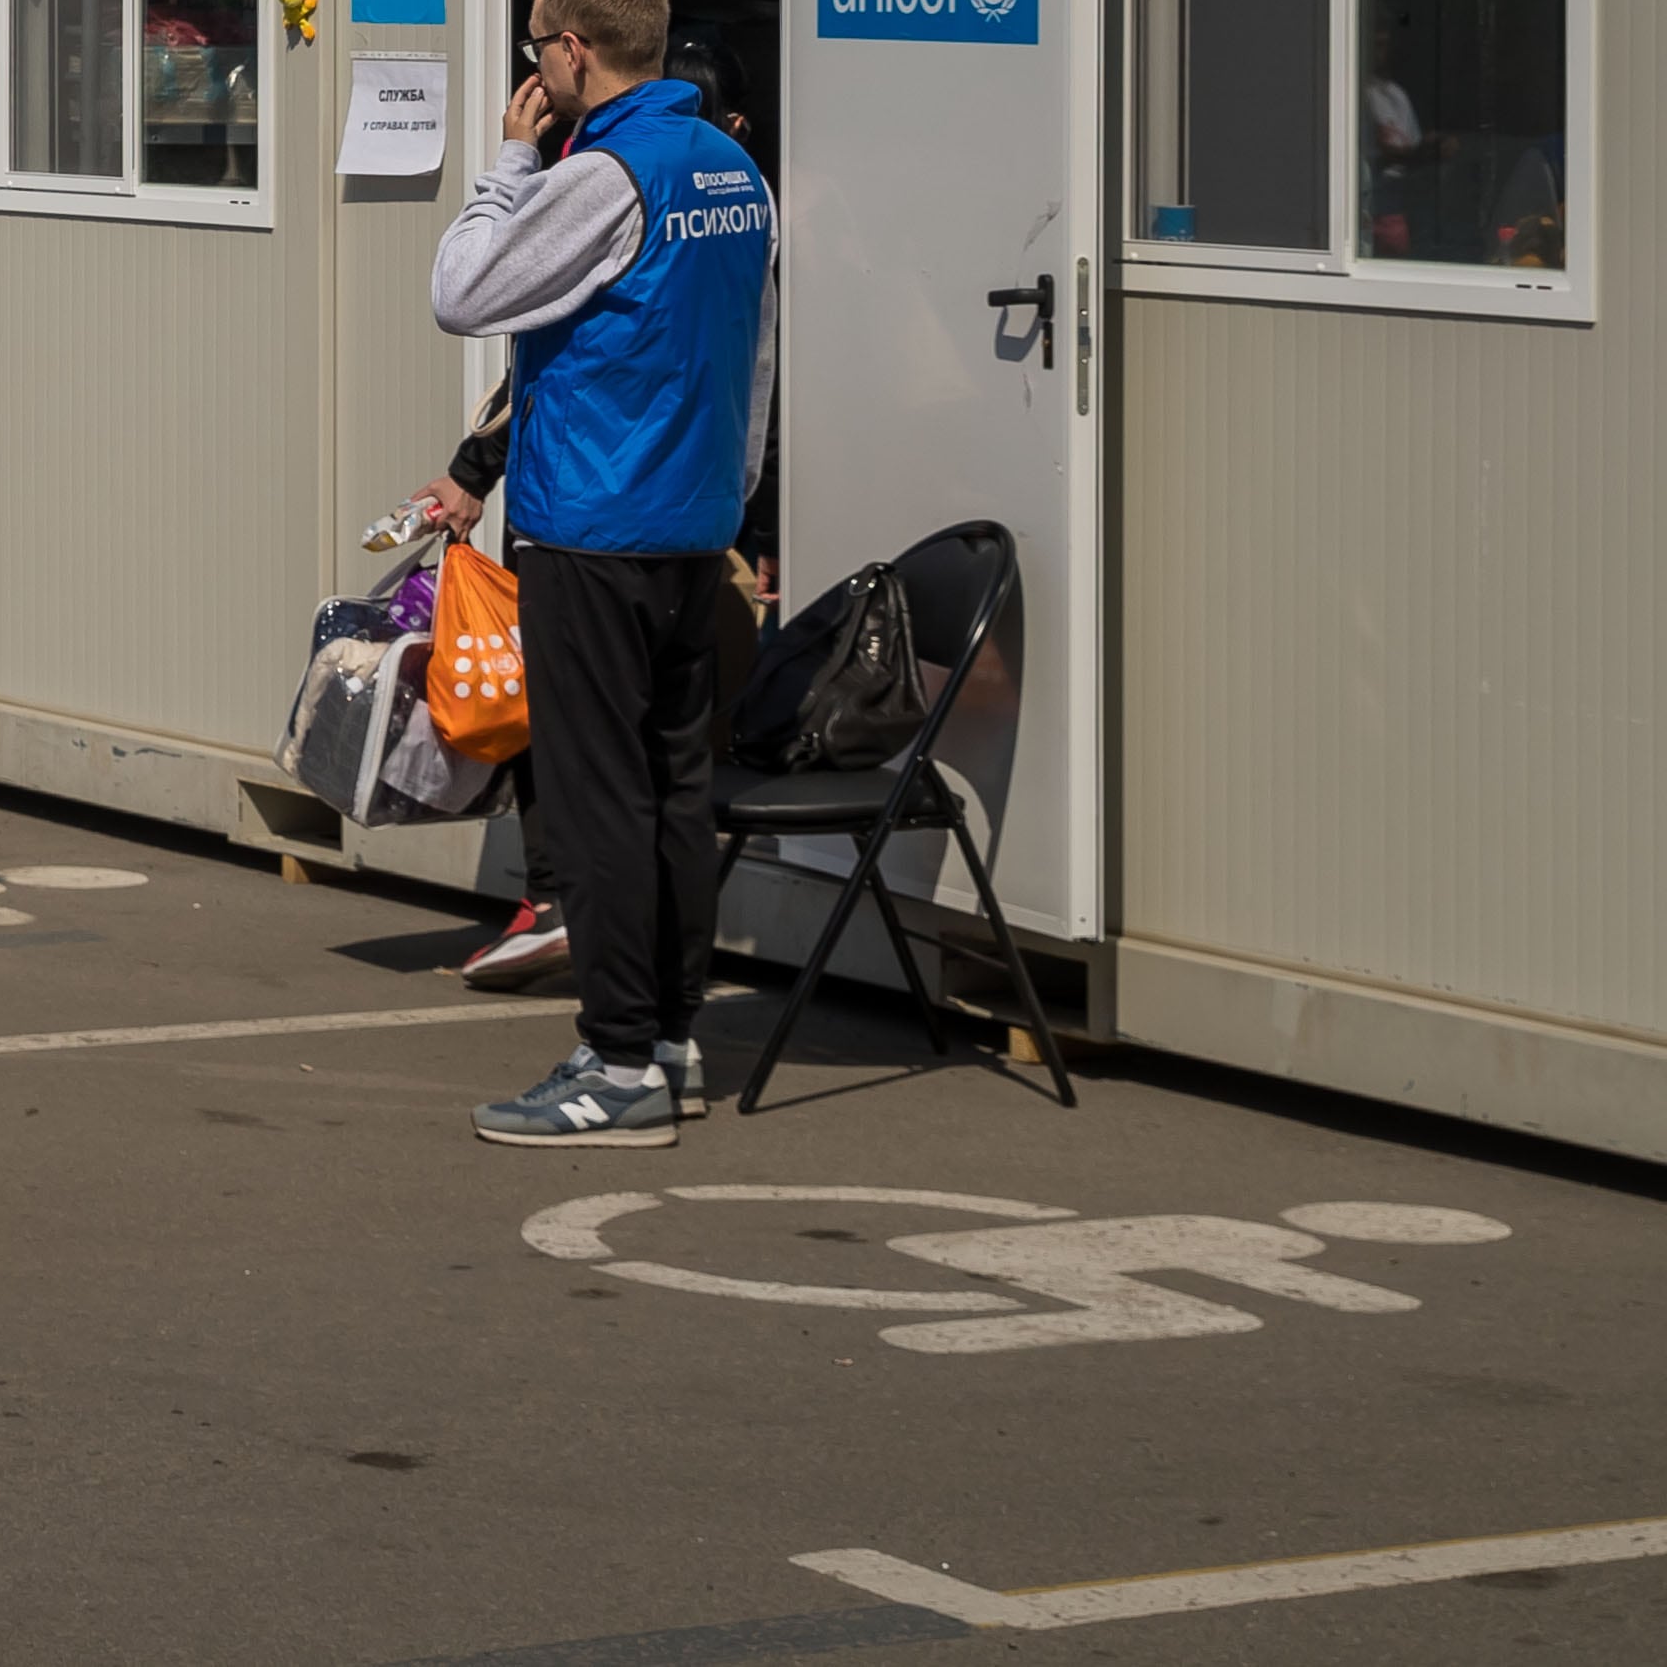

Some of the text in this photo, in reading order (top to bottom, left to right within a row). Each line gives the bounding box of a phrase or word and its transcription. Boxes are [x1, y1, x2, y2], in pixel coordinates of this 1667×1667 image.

[378, 89, 426, 103] СЛУЖБА
[370, 121, 409, 131] СПРАВАХ
[411, 119, 437, 132] ДІТЕЙ
[666, 203, 768, 242] ПСИХОЛ
